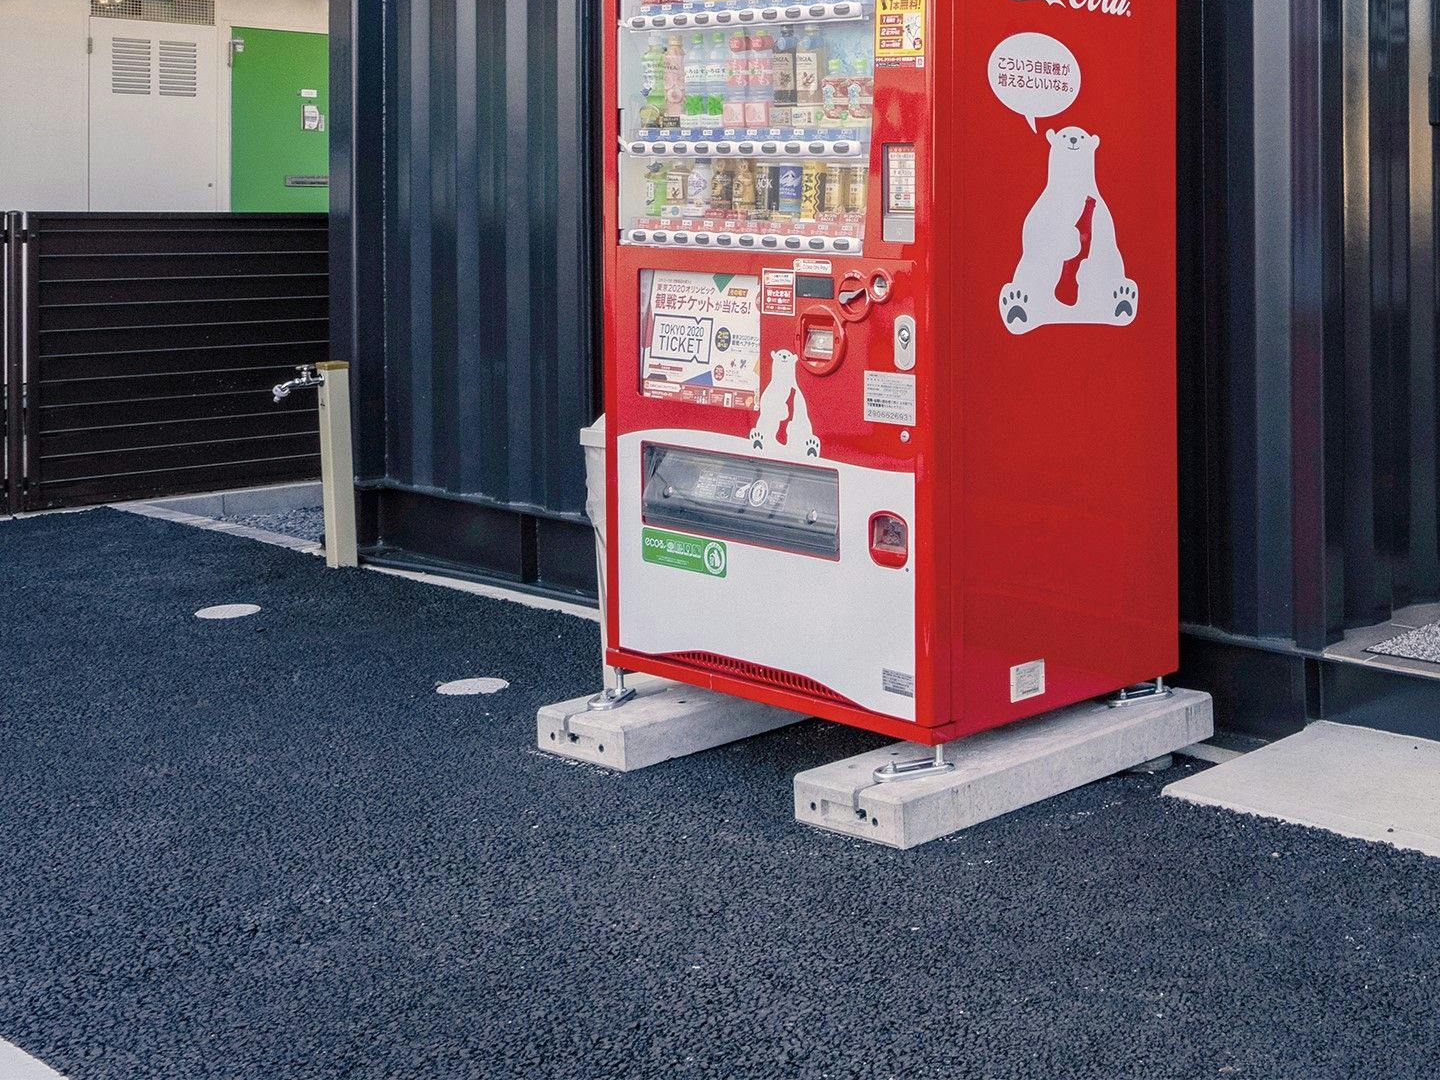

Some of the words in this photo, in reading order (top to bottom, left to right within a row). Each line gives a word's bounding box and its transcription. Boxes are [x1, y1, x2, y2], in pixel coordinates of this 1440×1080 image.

[997, 57, 1070, 76] こういう自販機が
[997, 72, 1074, 93] 増えるといいなぁ。
[804, 173, 813, 203] MAX
[656, 283, 716, 295] 東京2020オリンピック
[655, 293, 752, 315] 観戦チケットが当たる!
[660, 323, 686, 335] TOKYO
[687, 325, 705, 338] 2020
[659, 335, 703, 354] TICKET
